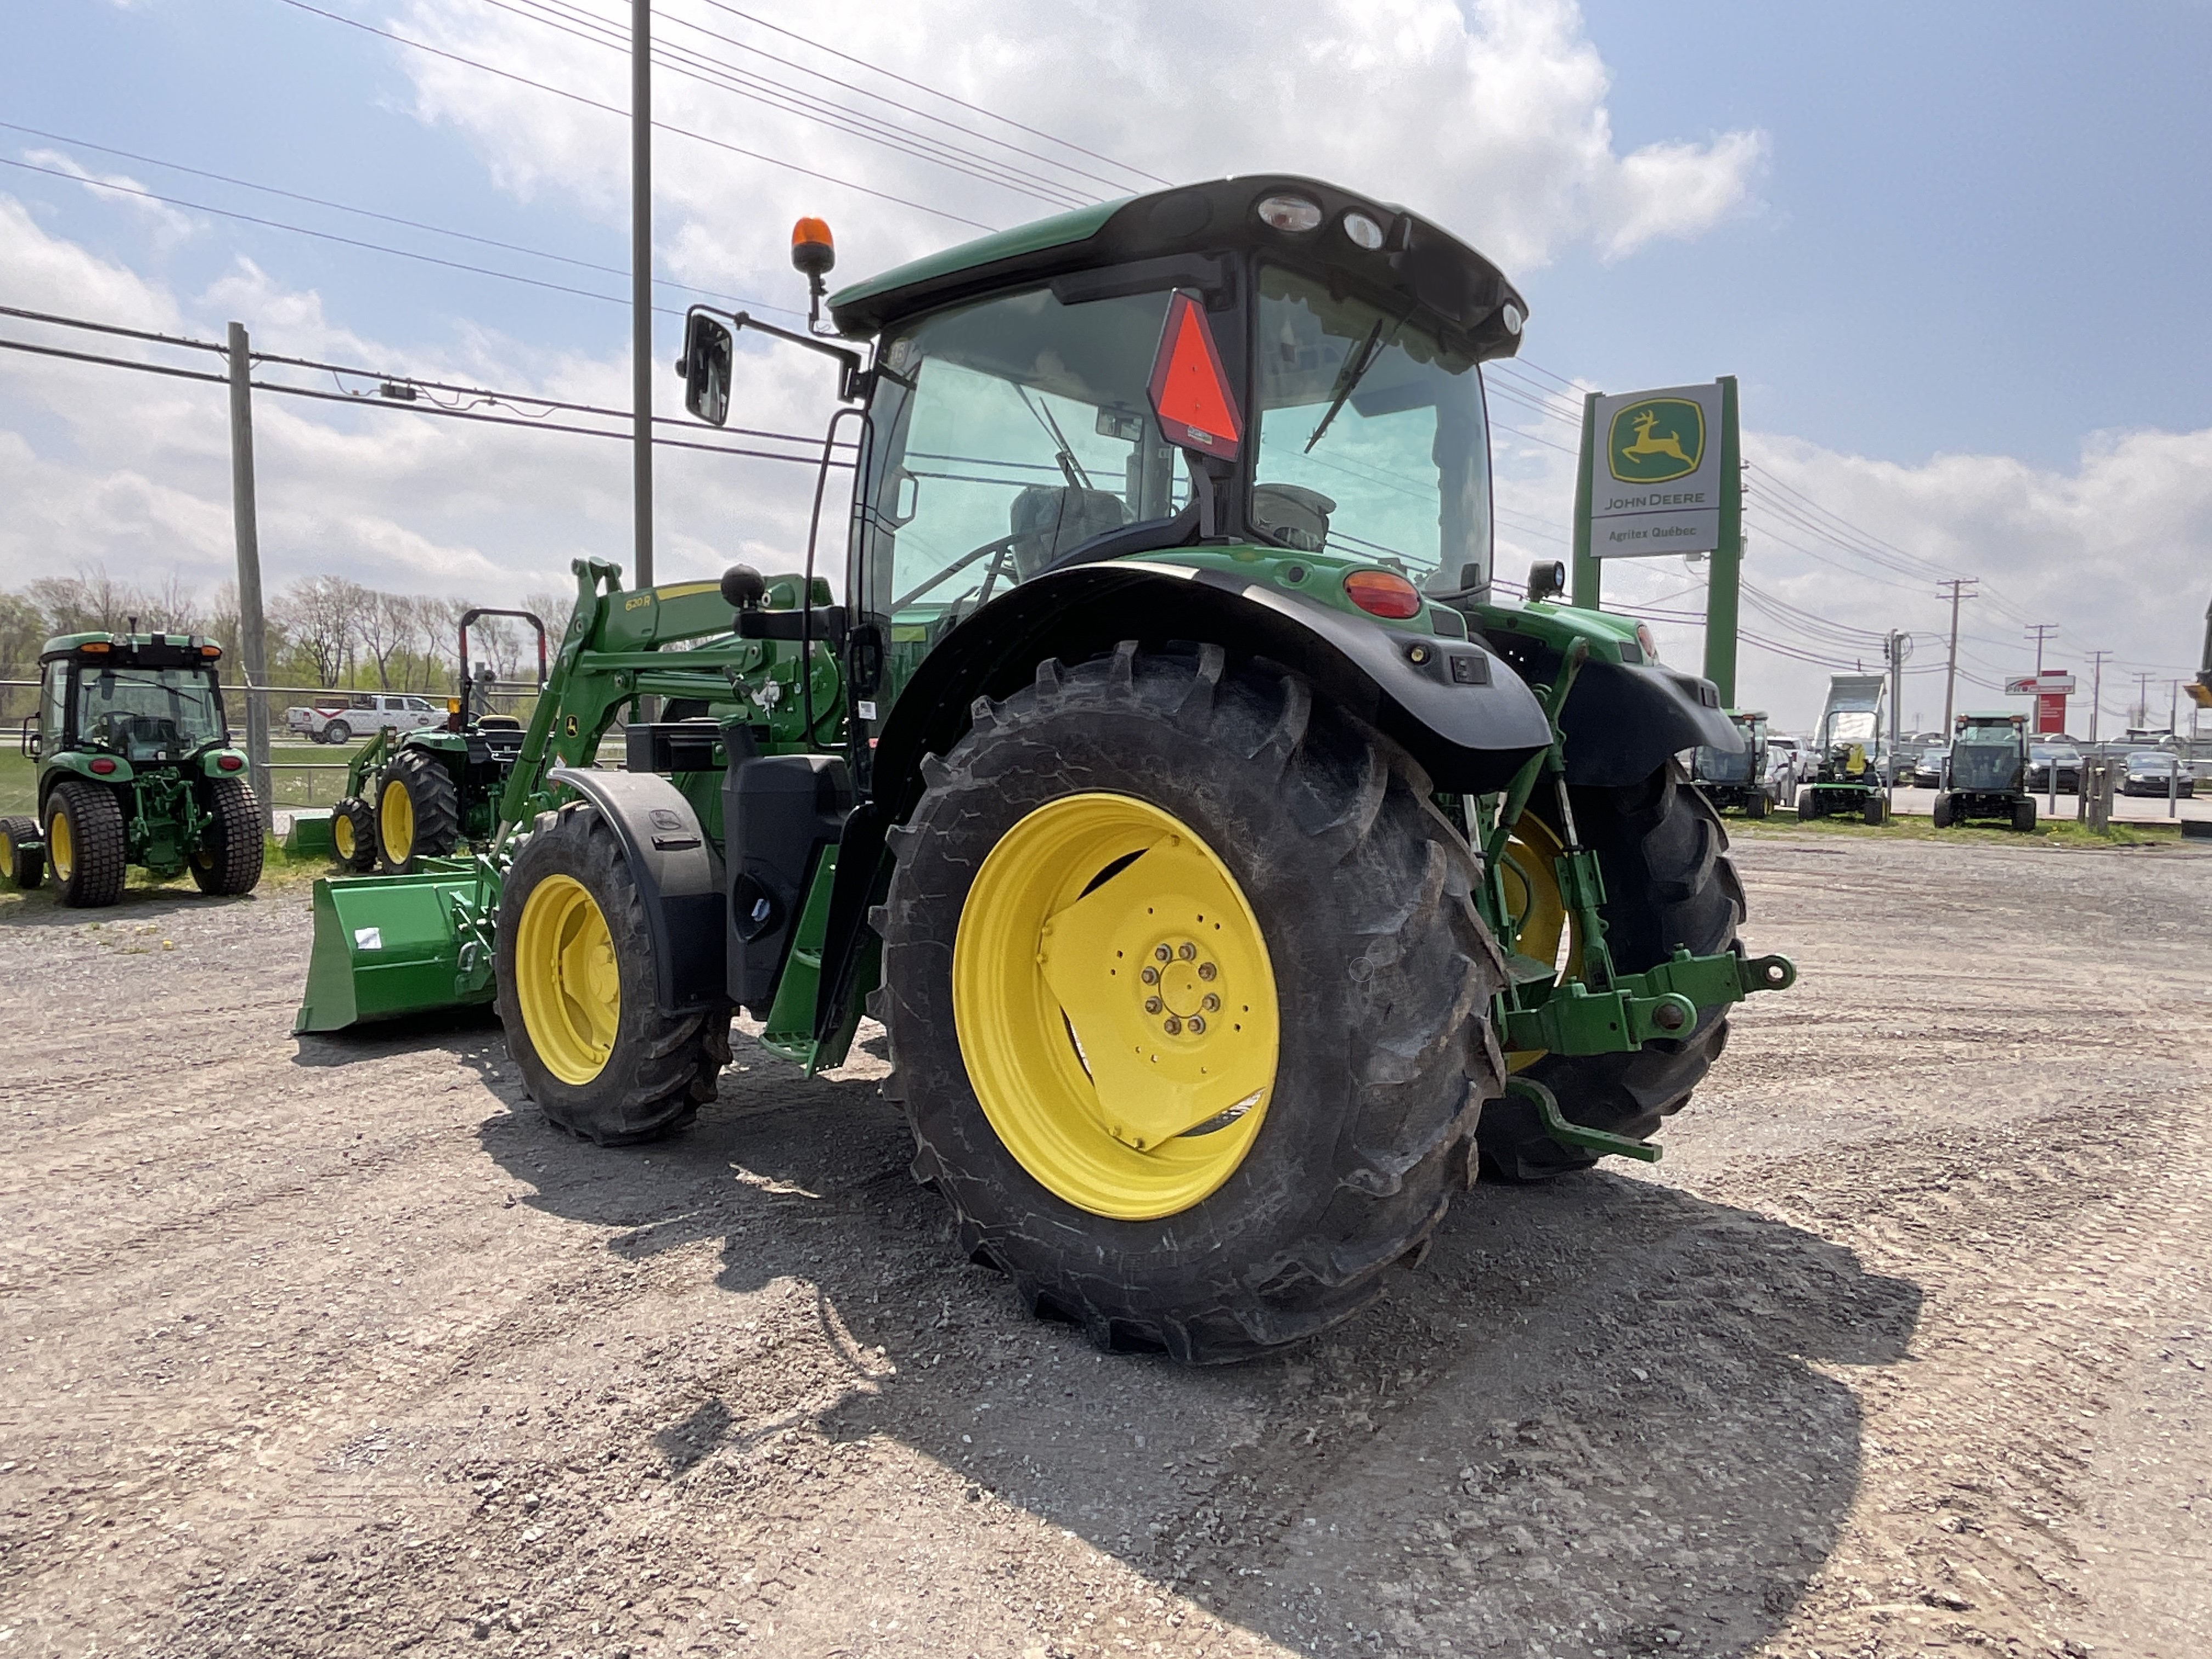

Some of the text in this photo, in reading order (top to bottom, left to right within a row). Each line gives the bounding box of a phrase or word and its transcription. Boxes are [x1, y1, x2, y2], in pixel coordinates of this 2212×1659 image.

[1605, 493, 1705, 510] JOHN DEERE
[1609, 526, 1697, 542] Agritex Québec
